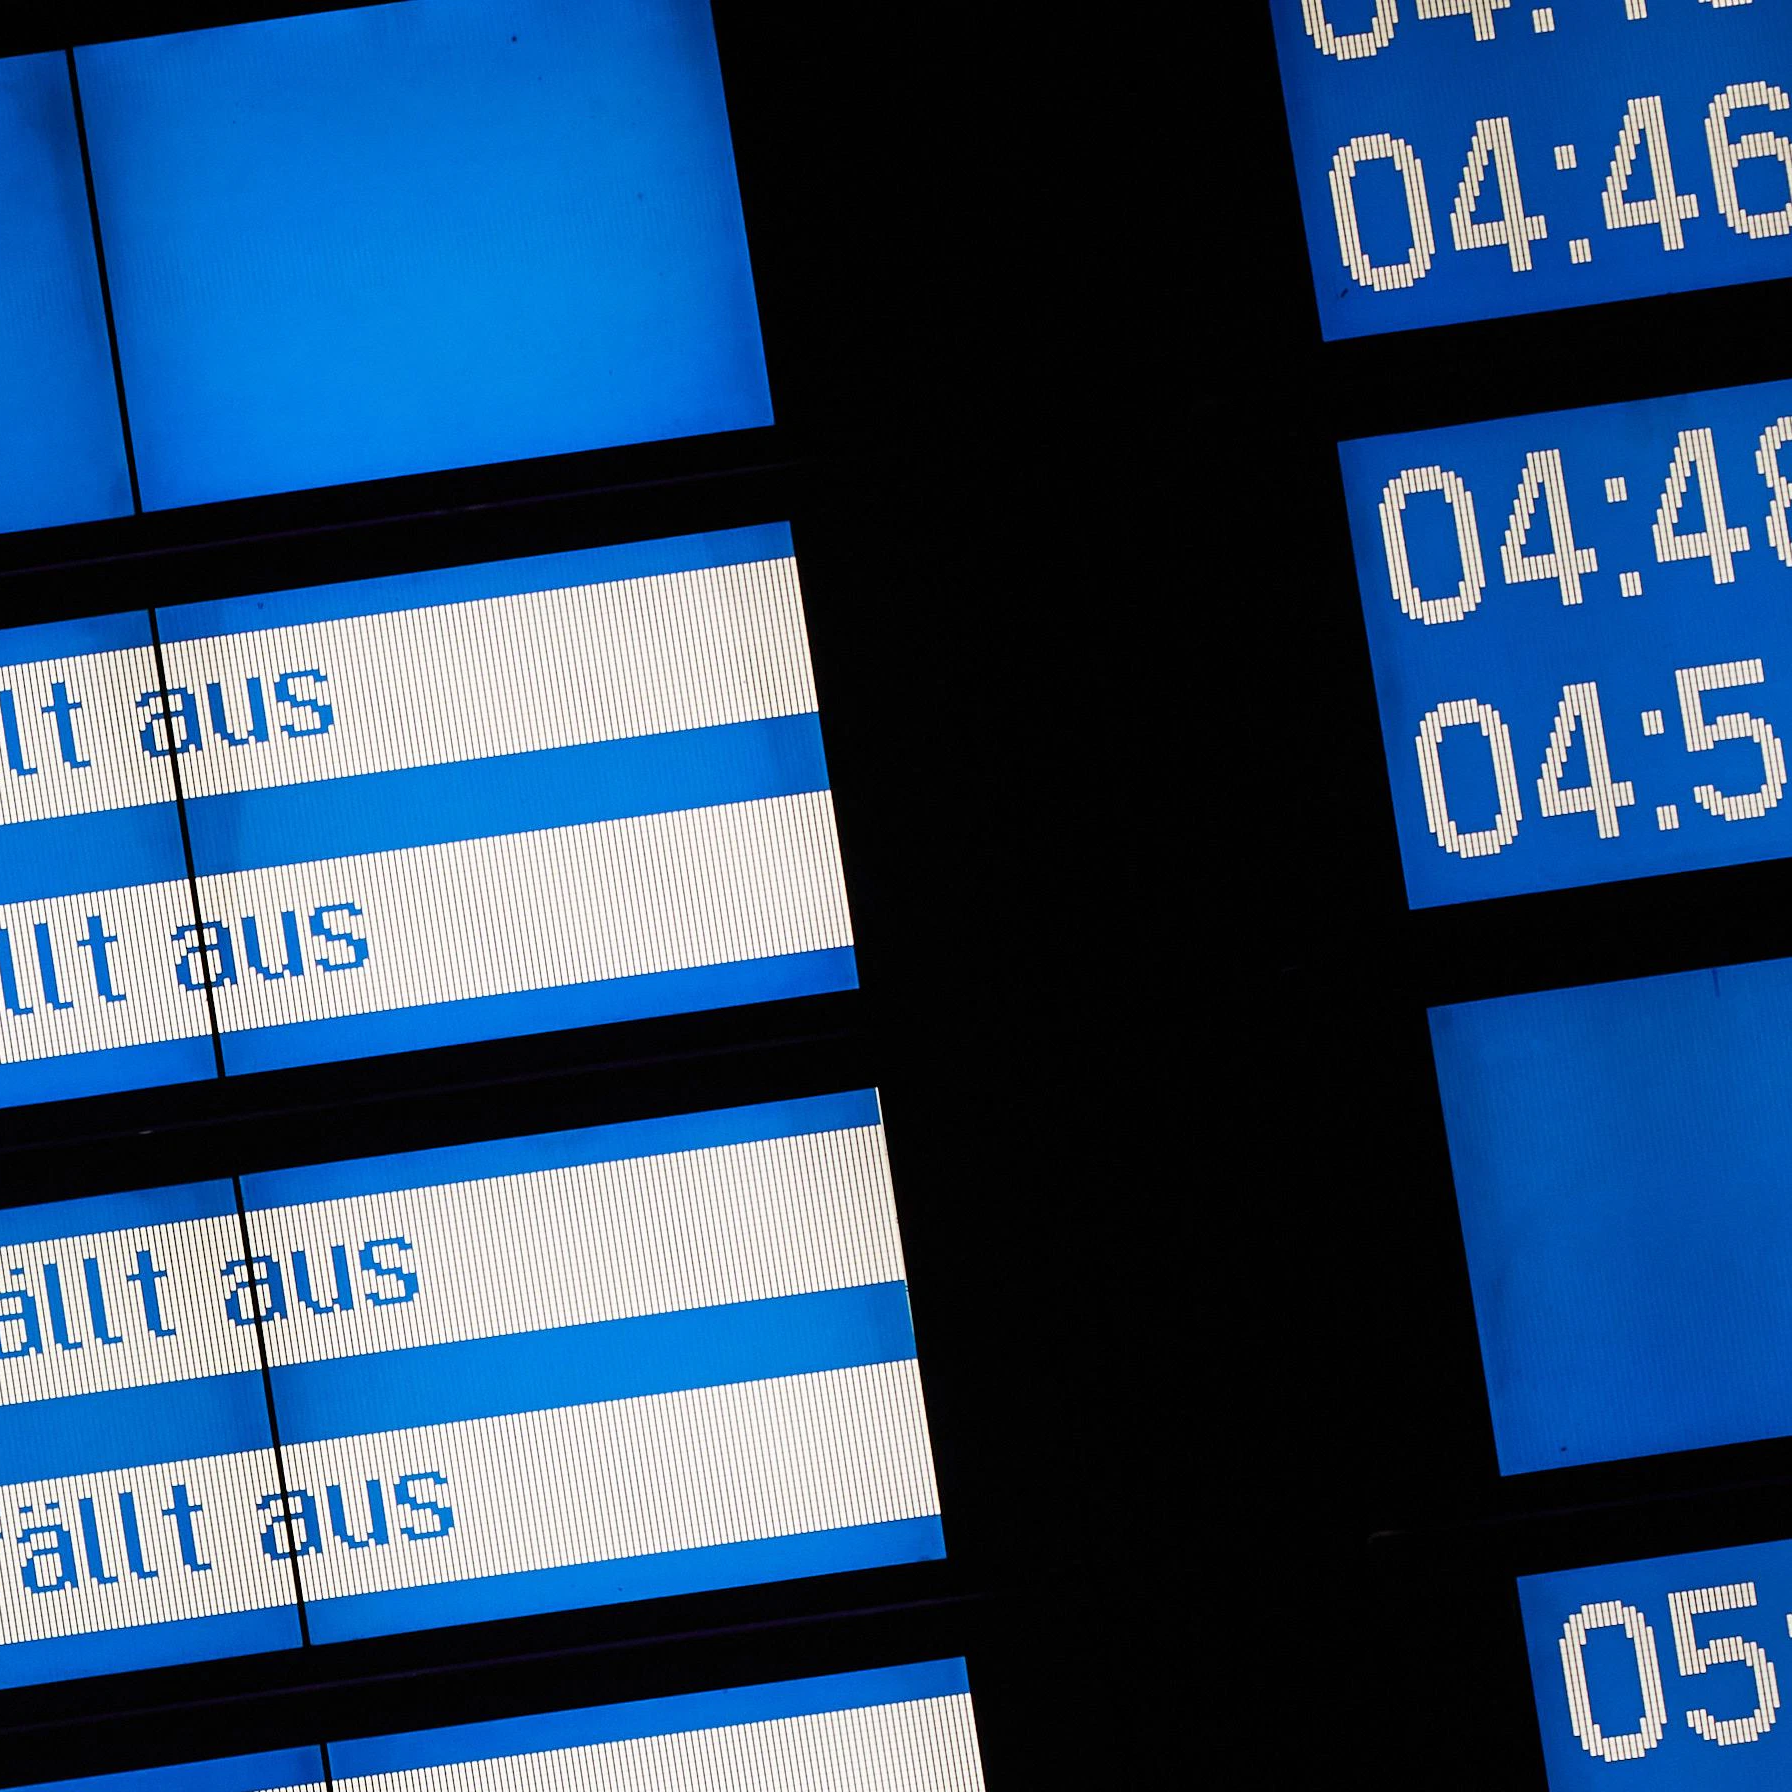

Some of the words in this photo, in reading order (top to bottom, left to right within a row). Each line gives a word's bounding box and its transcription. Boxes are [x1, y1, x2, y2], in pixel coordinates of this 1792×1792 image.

[1327, 79, 1792, 293] 04:46
[138, 667, 336, 759] aus
[169, 900, 371, 993] aus
[220, 1235, 421, 1328] aus
[257, 1469, 457, 1562] aus
[1557, 1580, 1792, 1764] 05
